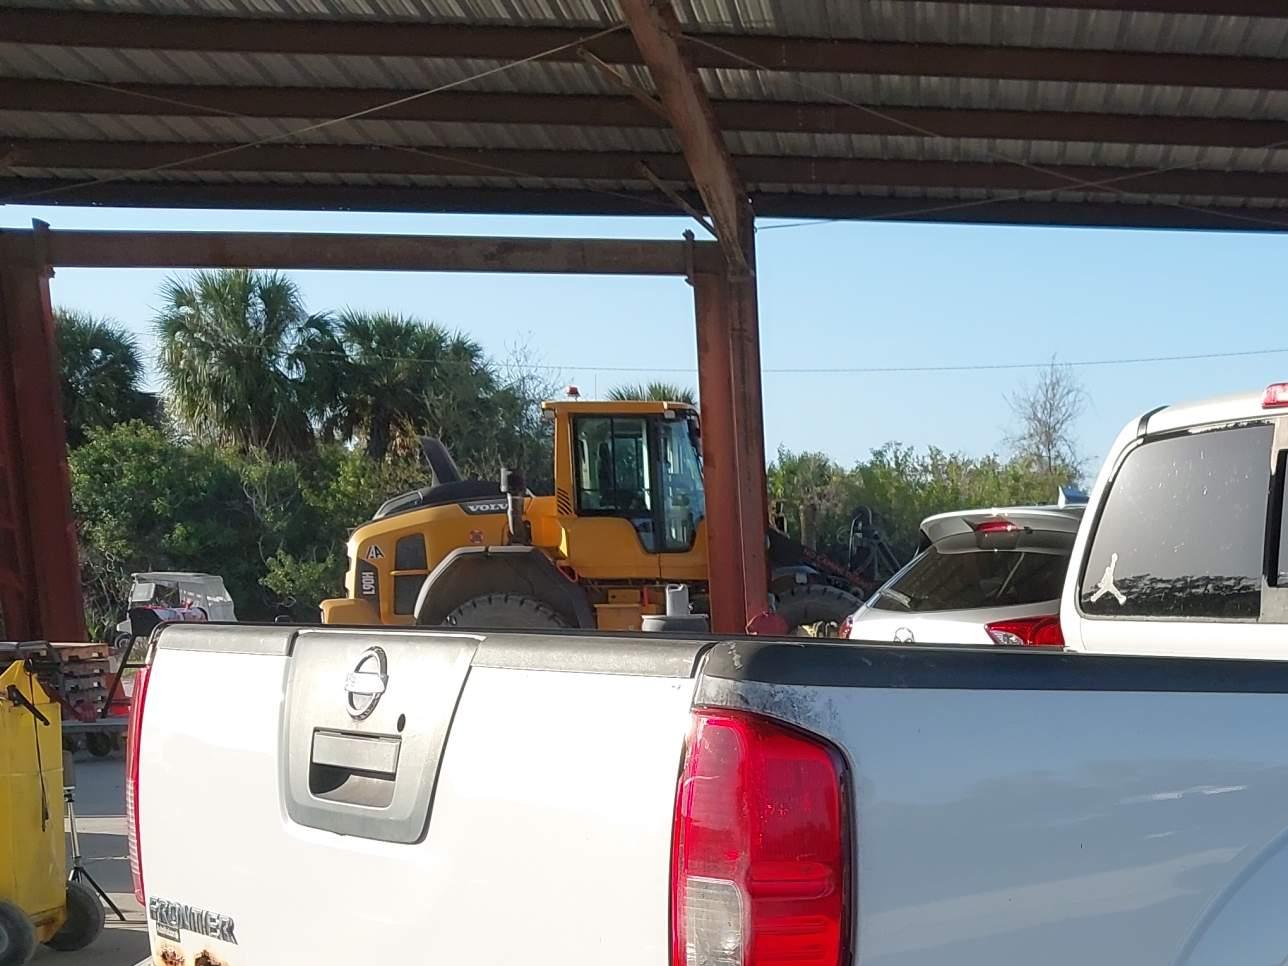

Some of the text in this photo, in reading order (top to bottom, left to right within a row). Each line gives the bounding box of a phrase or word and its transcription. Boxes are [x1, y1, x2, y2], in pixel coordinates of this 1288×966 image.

[468, 503, 508, 512] VOLV
[361, 571, 376, 595] L90H
[149, 896, 239, 945] FRONTIER
